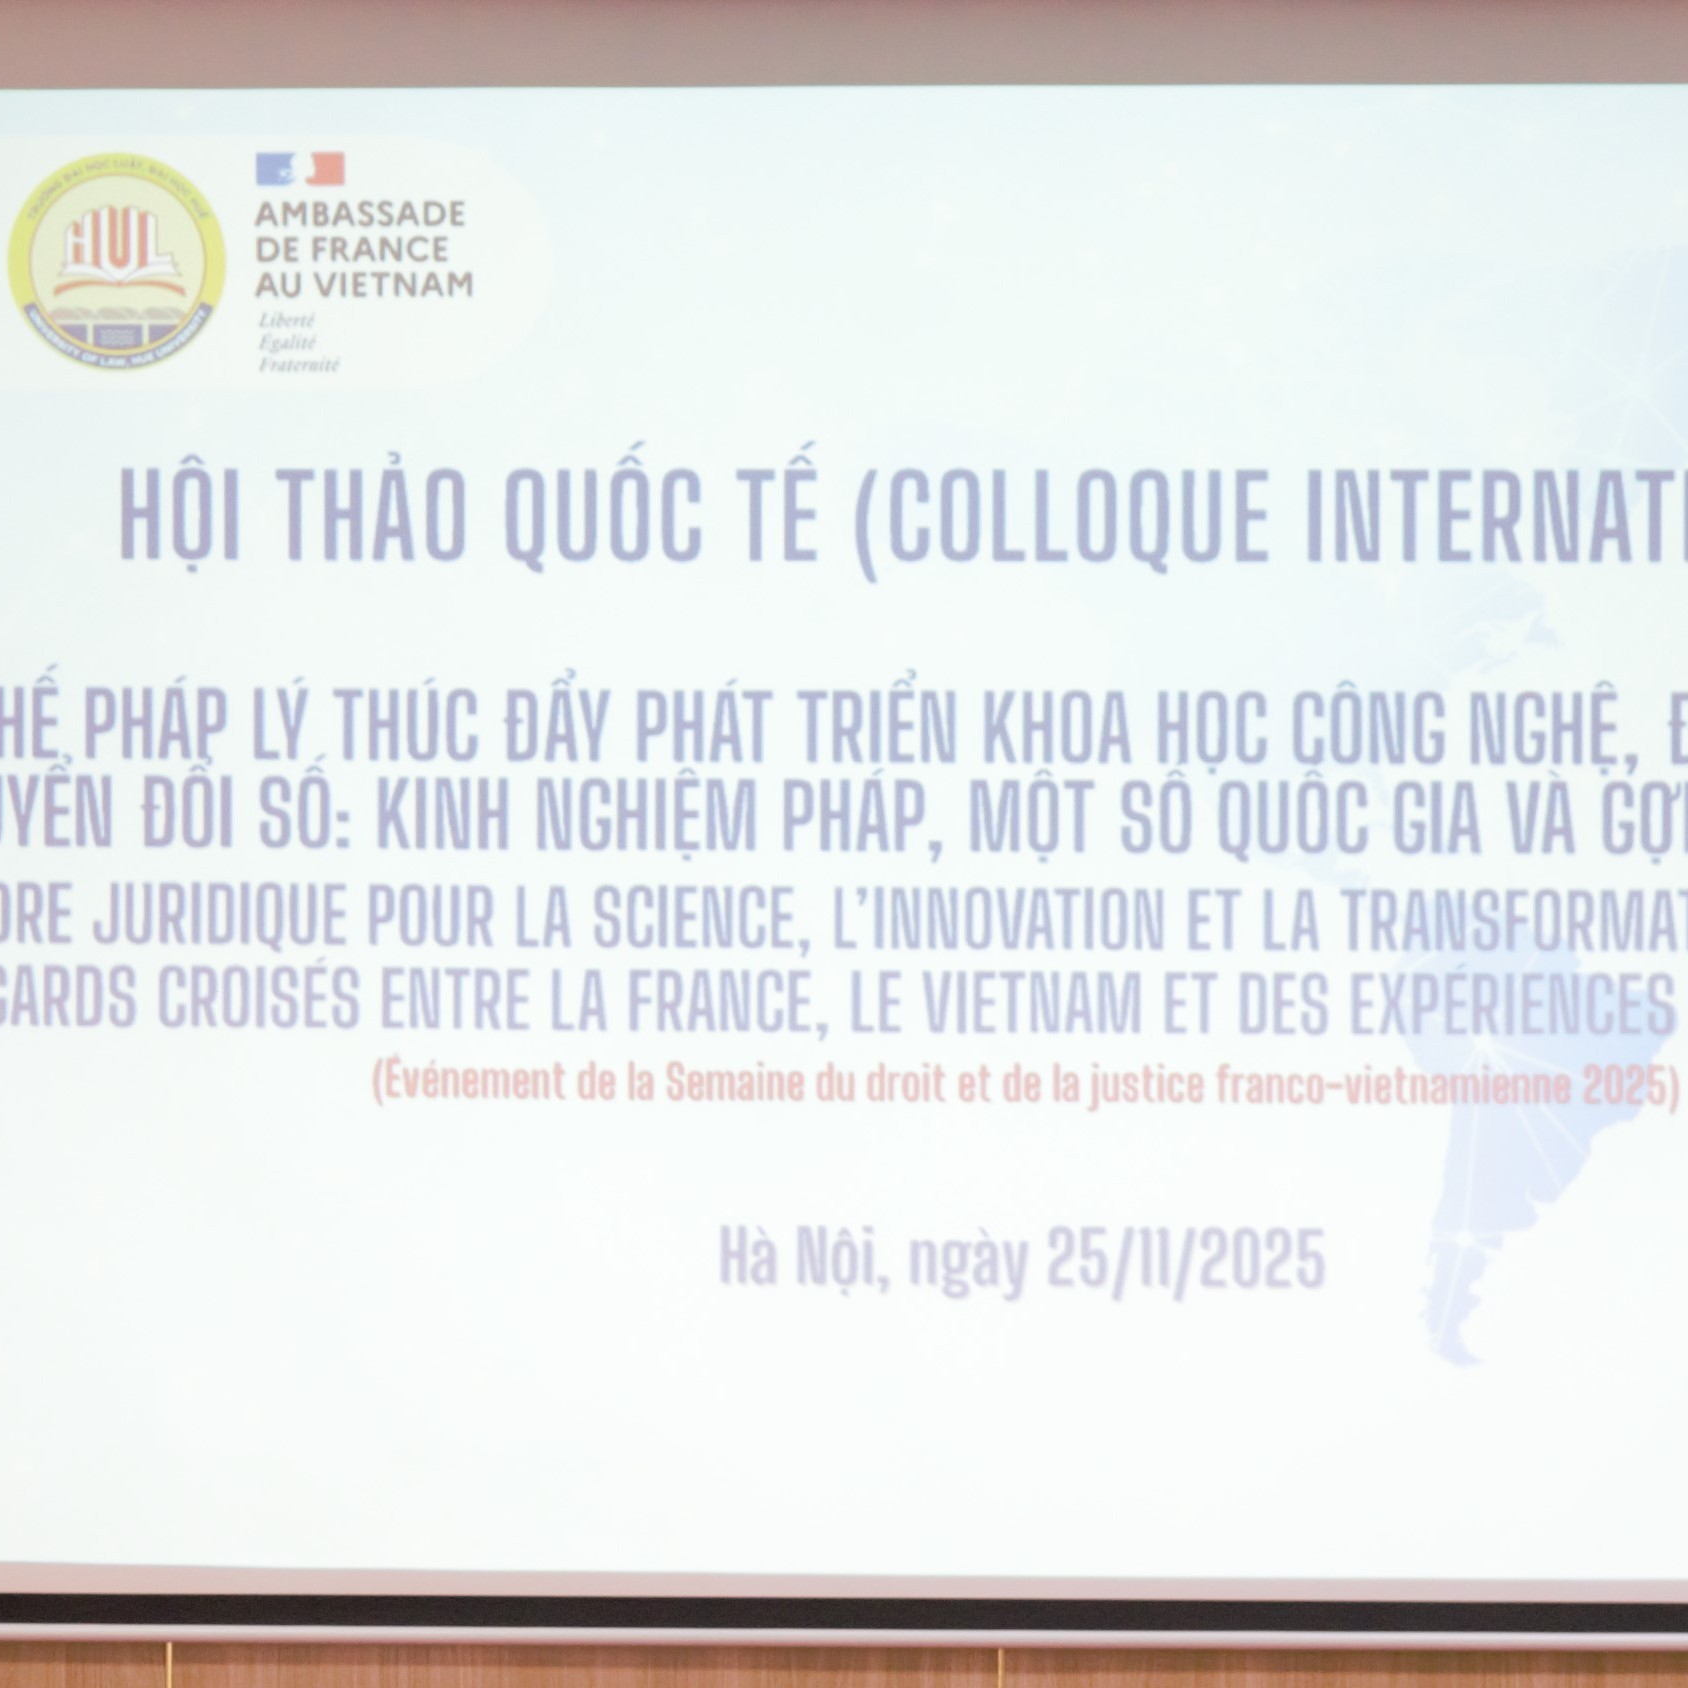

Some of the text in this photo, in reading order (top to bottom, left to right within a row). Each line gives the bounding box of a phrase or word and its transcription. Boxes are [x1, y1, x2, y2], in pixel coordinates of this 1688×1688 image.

[64, 204, 175, 276] HUL
[254, 200, 466, 227] AMBASSADE
[256, 235, 449, 263] DE FRANCE
[254, 271, 474, 298] AU VIETNAM
[258, 311, 316, 331] Liberté
[258, 332, 317, 354] Égalité
[258, 355, 341, 373] Fraternité
[120, 454, 240, 573] HỘI
[274, 452, 467, 563] THẢO
[504, 441, 703, 573] QUỐC
[736, 441, 819, 563] TẾ
[853, 467, 1270, 585] (COLLOQUE
[84, 676, 228, 761] PHÁP
[252, 676, 309, 762] LÝ
[333, 677, 479, 763] THÚC
[505, 667, 611, 763] ĐẨY
[636, 678, 774, 764] PHÁT
[796, 668, 958, 765] TRIỂN
[984, 690, 1132, 765] KHOA
[1157, 690, 1267, 775] HỌC
[1291, 680, 1446, 766] CÔNG
[1469, 681, 1639, 776] NGHỆ,
[141, 756, 233, 849] ĐỔI
[258, 754, 350, 850] SỐ:
[377, 777, 510, 851] KINH
[537, 768, 757, 862] NGHIỆM
[783, 766, 943, 863] PHÁP,
[970, 769, 1095, 863] MỘT
[1119, 761, 1192, 855] SỐ
[1217, 759, 1369, 862] QUỐC
[1393, 778, 1482, 855] GIA
[1508, 769, 1575, 855] VÀ
[93, 882, 348, 953] JURIDIQUE
[367, 883, 494, 948] POUR
[516, 885, 572, 948] LA
[593, 885, 811, 958] SCIENCE,
[833, 886, 1165, 951] L’INNOVATION
[1188, 888, 1241, 951] ET
[1263, 888, 1319, 951] LA
[158, 957, 361, 1030] CROISÉS
[380, 968, 531, 1030] ENTRE
[551, 969, 607, 1031] LA
[627, 969, 829, 1043] FRANCE,
[850, 971, 902, 1033] LE
[921, 971, 1142, 1033] VIETNAM
[1164, 972, 1218, 1034] ET
[1238, 972, 1330, 1035] DES
[1349, 963, 1676, 1036] EXPÉRIENCES
[372, 1053, 1680, 1114] (Événement de la Semaine du droit et de la justice franco-vietnamienne 2025)
[719, 1225, 779, 1287] Hà
[795, 1225, 890, 1298] Nội,
[908, 1227, 1029, 1299] ngày
